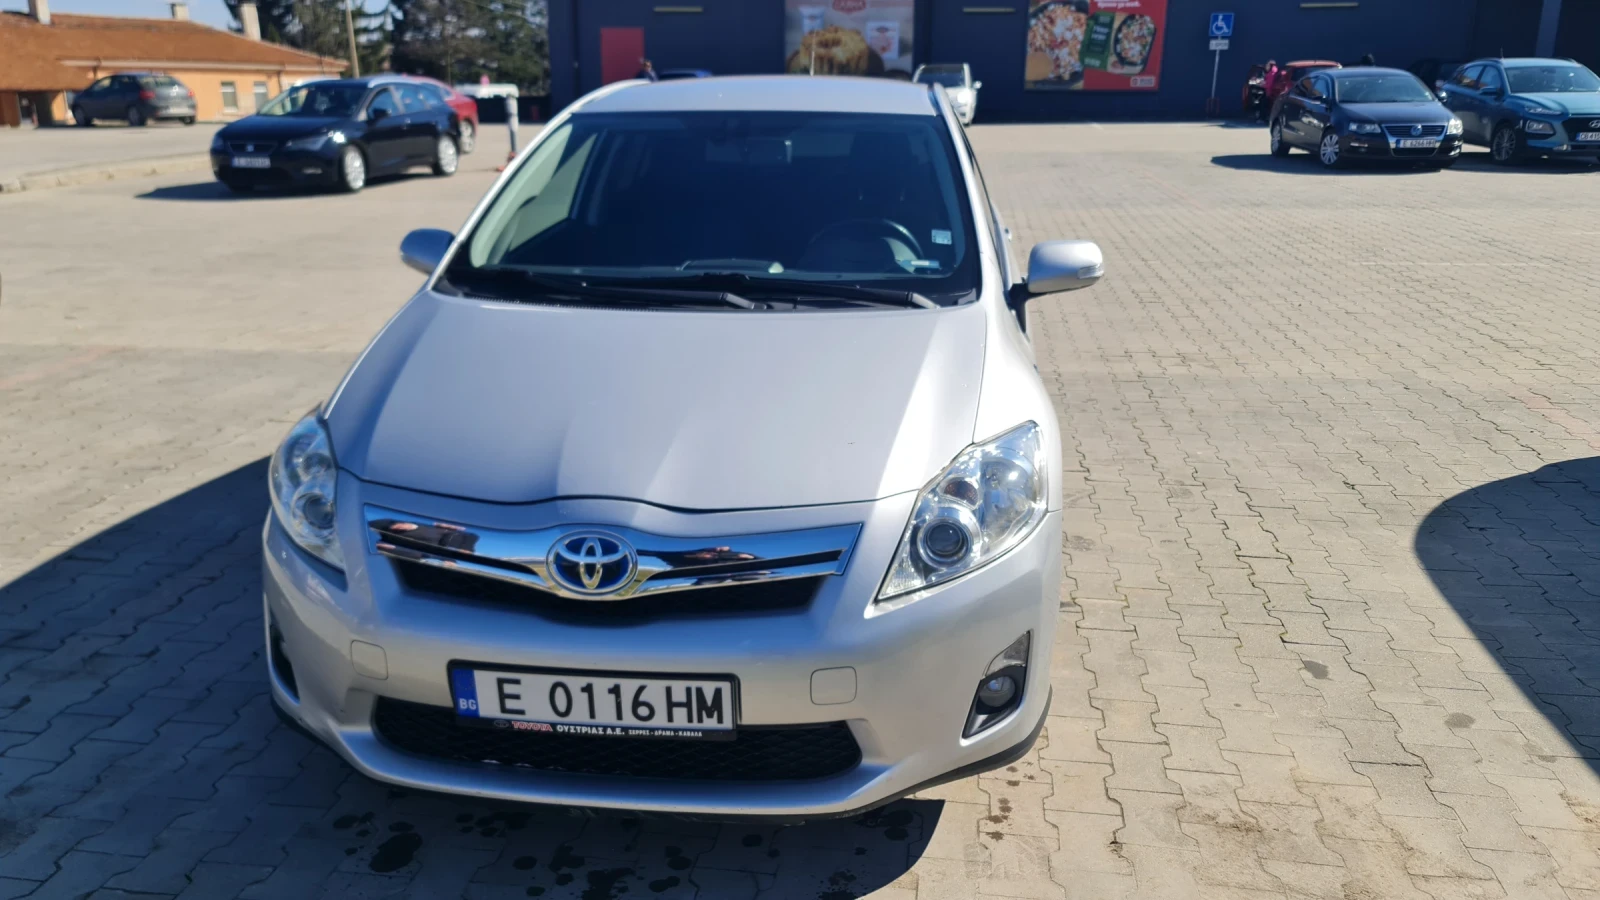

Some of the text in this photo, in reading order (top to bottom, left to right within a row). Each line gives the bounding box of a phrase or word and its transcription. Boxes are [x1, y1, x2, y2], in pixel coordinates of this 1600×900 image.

[459, 698, 477, 710] BG
[496, 677, 725, 725] E 0116 HM
[511, 721, 553, 732] TOYOTA
[556, 724, 605, 735] ΟΥΣΤΡΙΑΣ
